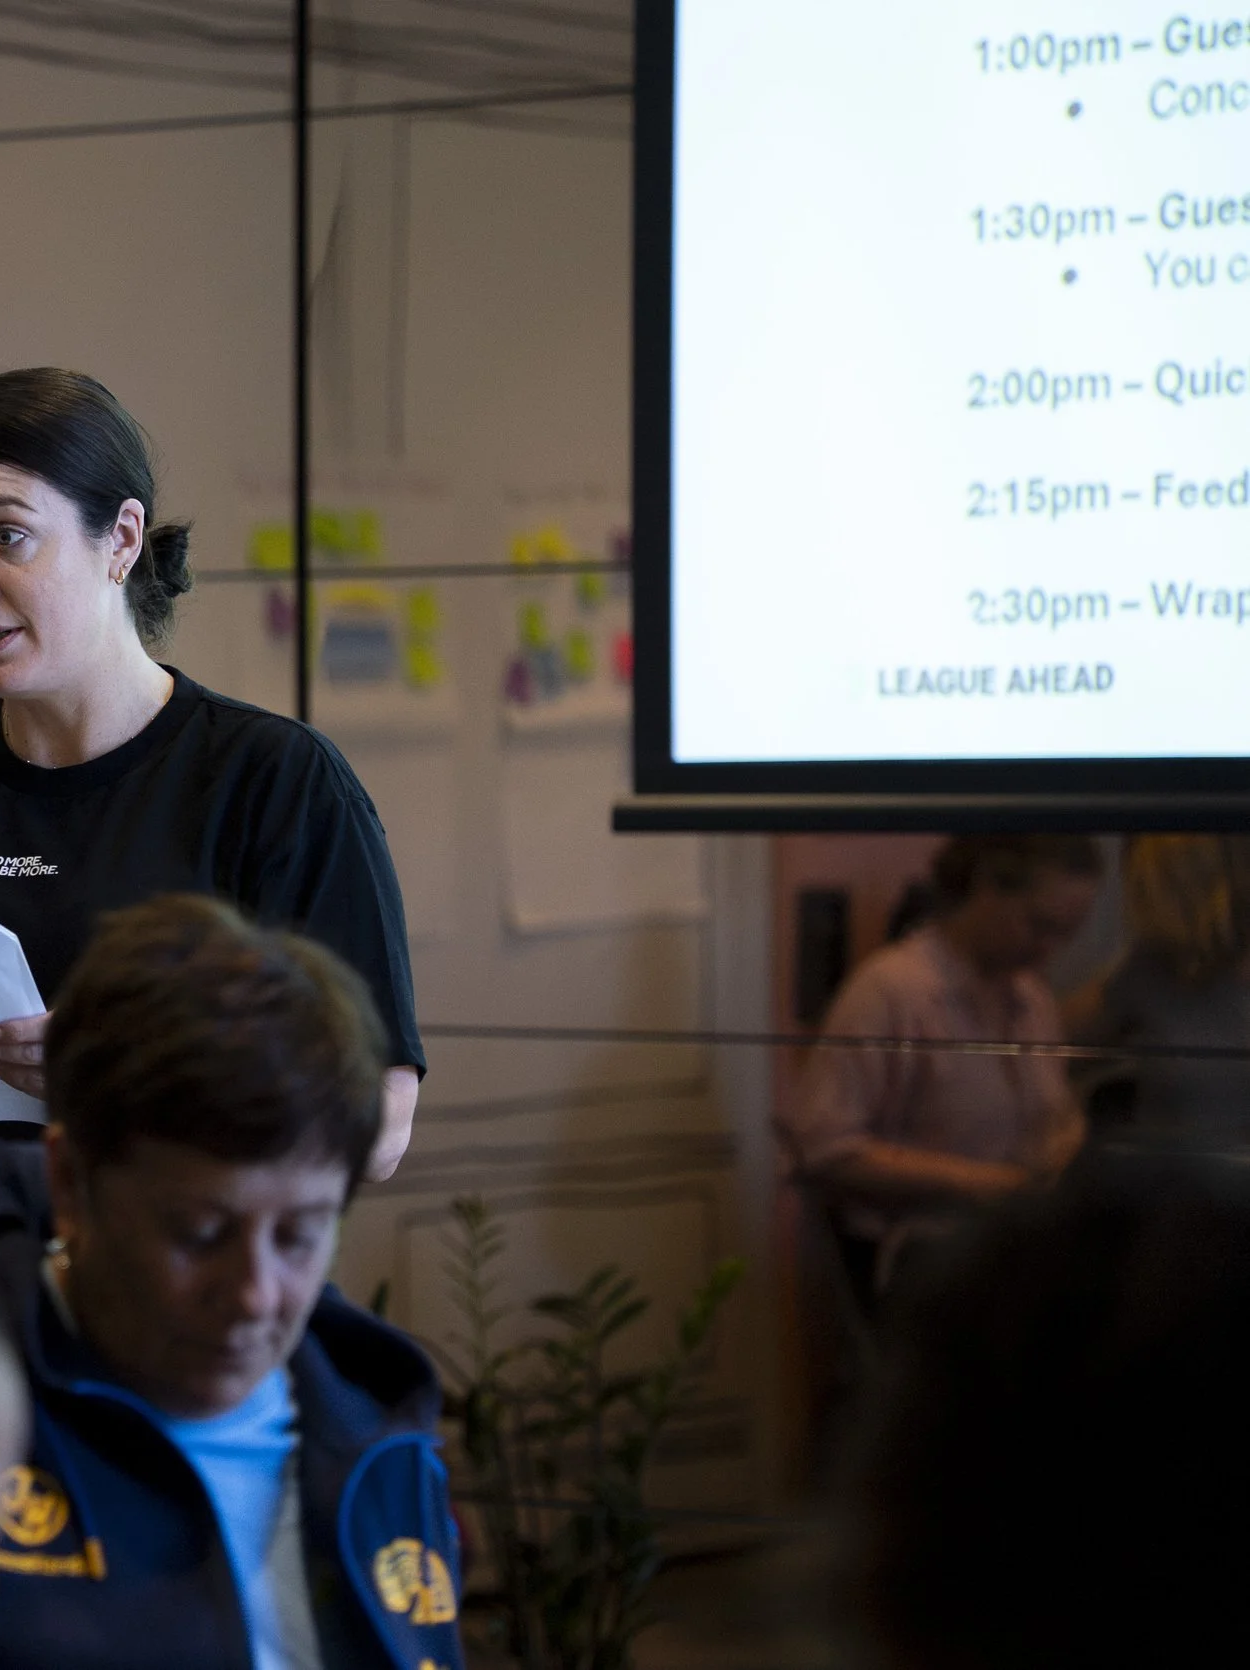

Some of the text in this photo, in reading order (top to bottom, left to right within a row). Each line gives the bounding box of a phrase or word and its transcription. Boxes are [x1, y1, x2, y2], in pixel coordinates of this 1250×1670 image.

[976, 33, 1121, 73] 1:00pm
[1163, 16, 1250, 55] Gue
[971, 203, 1116, 243] 1:30pm
[1145, 250, 1216, 288] You
[967, 369, 1111, 410] 2:00pm
[967, 479, 1110, 519] 2:15pm
[1154, 471, 1250, 507] Feed
[967, 588, 1110, 629] 2:30pm
[878, 663, 1115, 697] LEAGUE AHEAD
[0, 865, 59, 877] BE MORE.
[4, 856, 43, 867] MORE.
